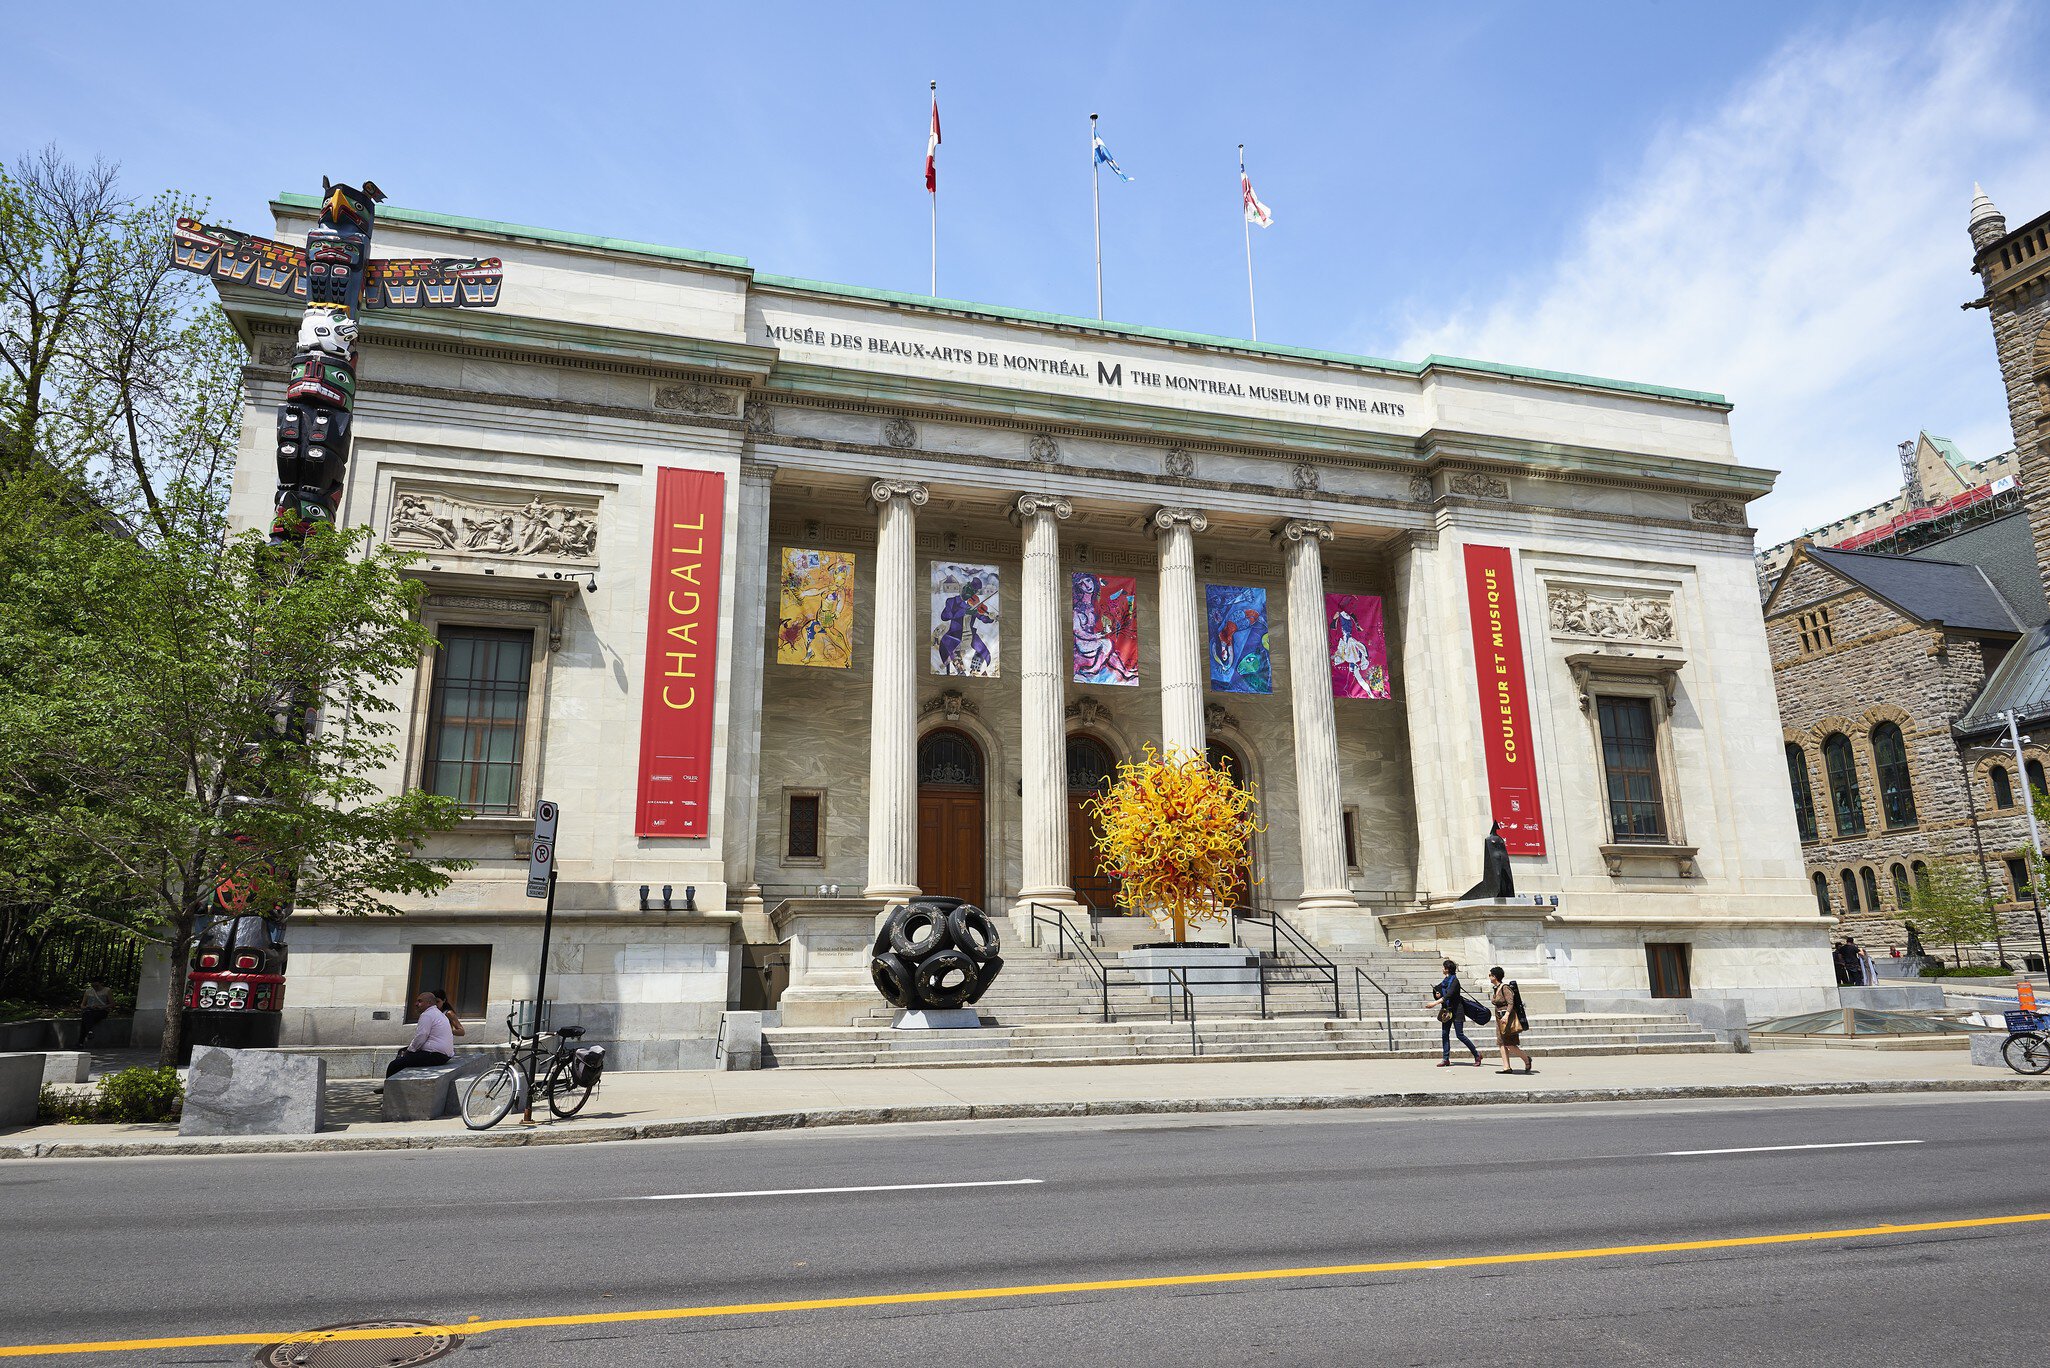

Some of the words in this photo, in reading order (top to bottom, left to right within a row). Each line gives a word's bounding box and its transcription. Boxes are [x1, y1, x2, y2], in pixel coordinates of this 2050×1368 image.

[765, 325, 825, 345] MUSÉE
[831, 333, 862, 350] DES
[868, 338, 972, 364] BEAUX-ARTS
[977, 352, 998, 366] DE
[1003, 354, 1089, 378] MONTRÉAL
[1097, 361, 1122, 386] M
[1131, 371, 1161, 387] THE
[1165, 374, 1245, 397] MONTREAL
[1249, 386, 1310, 404] MUSEUM
[1314, 394, 1331, 407] OF
[1335, 397, 1367, 412] FINE
[1371, 401, 1405, 416] ARTS
[662, 513, 704, 709] CHAGALL
[1485, 568, 1503, 647] MUSIQUE
[1495, 653, 1507, 674] ET
[1498, 681, 1517, 763] COULEUR
